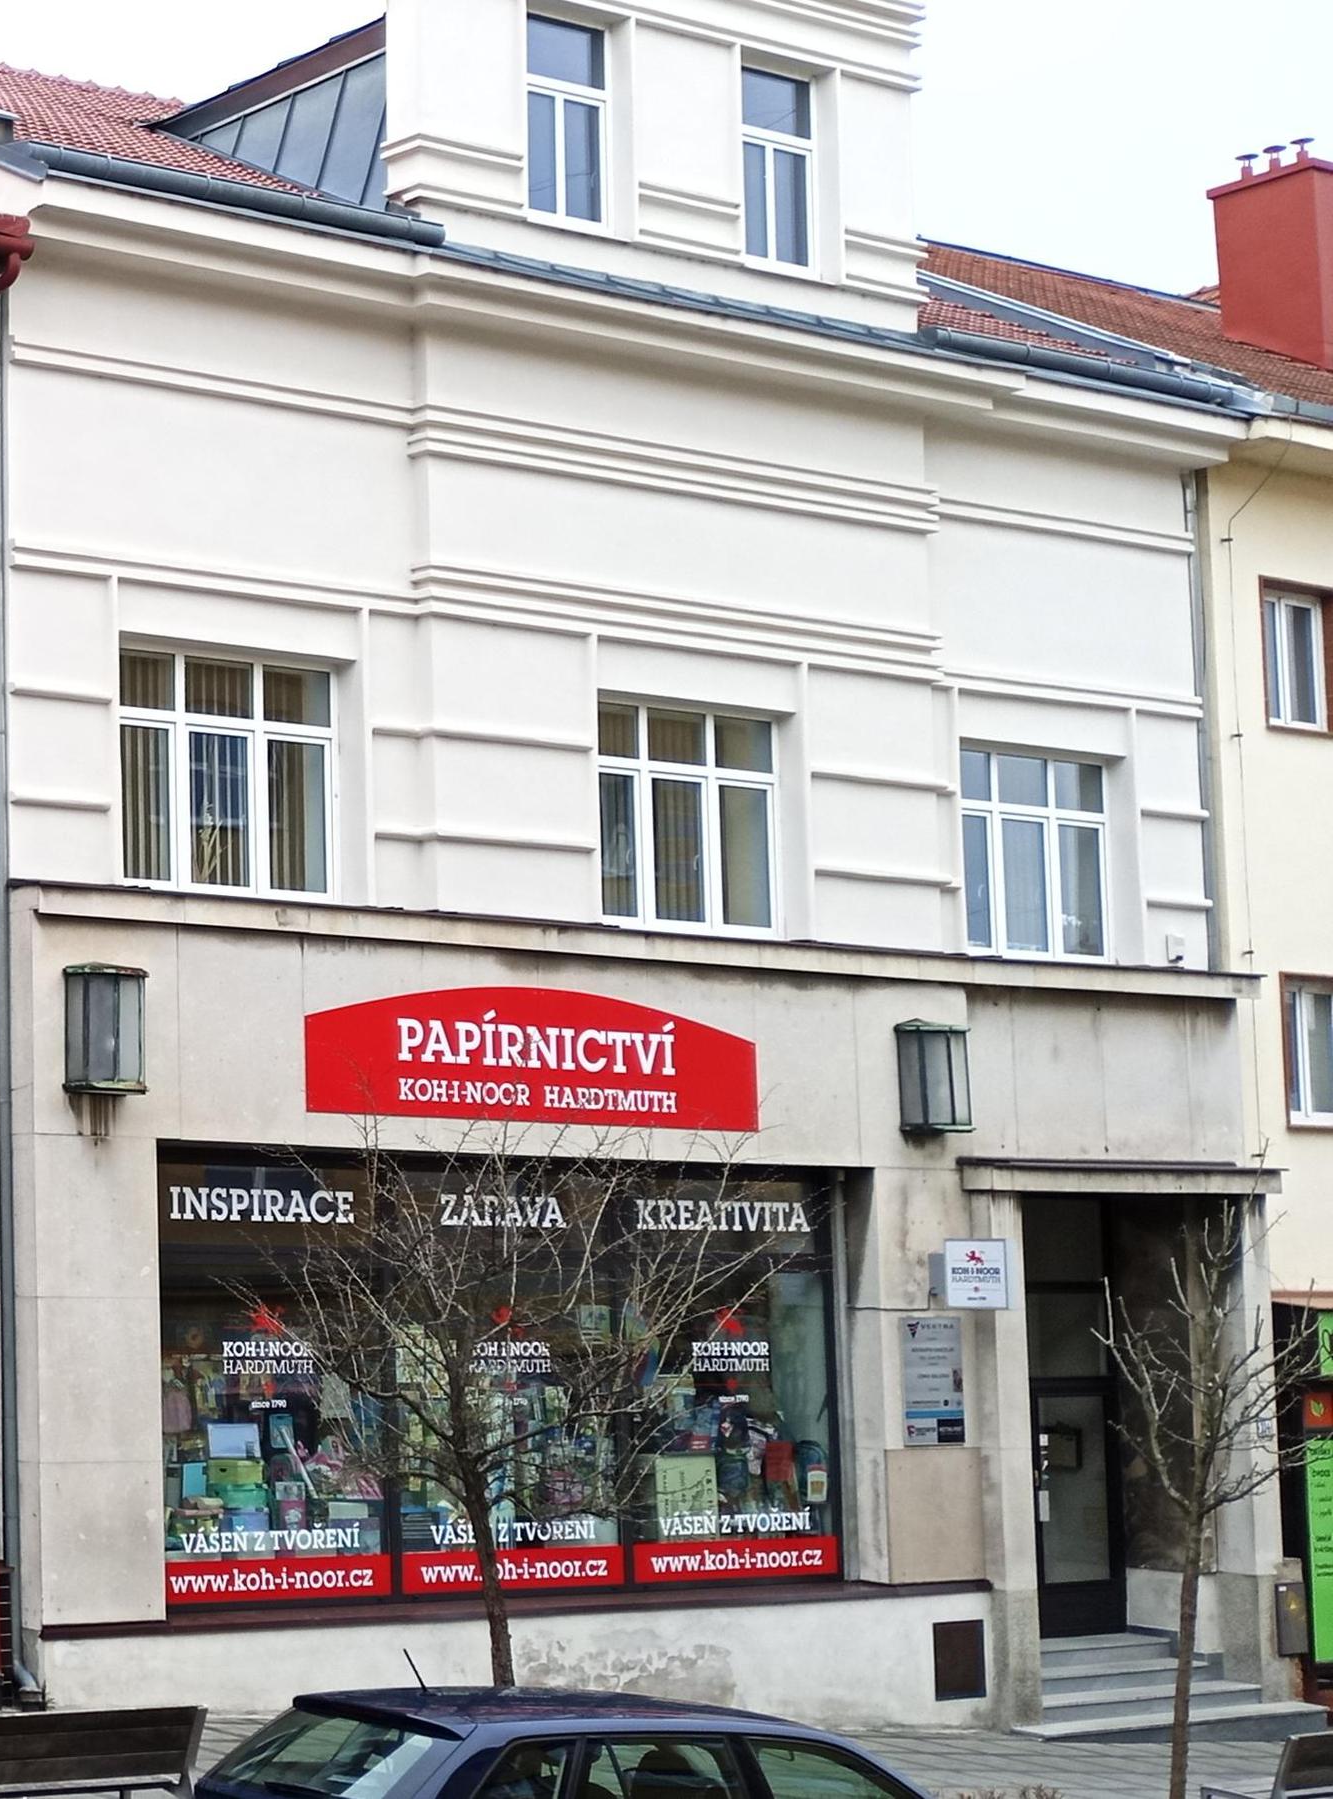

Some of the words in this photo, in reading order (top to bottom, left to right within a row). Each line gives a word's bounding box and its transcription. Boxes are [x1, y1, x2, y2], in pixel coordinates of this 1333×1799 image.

[396, 1008, 676, 1077] PAPÍRNICTVÍ
[398, 1077, 531, 1106] KOH-I-NOOR
[543, 1085, 677, 1113] HARDTMUTH
[169, 1186, 355, 1224] INSPIRACE
[440, 1184, 567, 1228] ZÁBAVA
[635, 1198, 811, 1233] KREATIVITA
[692, 1341, 769, 1357] KOH-I-NOOR
[223, 1360, 314, 1374] HARDTMUTH
[693, 1358, 770, 1372] HARDTMUTH
[251, 1400, 270, 1409] since
[498, 1522, 509, 1543] Z
[659, 1510, 717, 1537] VÁŠEŇ
[721, 1516, 732, 1534] Z
[732, 1506, 811, 1533] TVOŘENÍ
[182, 1526, 249, 1555] VÁŠEŇ
[253, 1531, 266, 1552] Z
[269, 1521, 361, 1551] TVOŘENÍ
[651, 1548, 823, 1573] www.koh-i-noor.cz
[170, 1566, 374, 1594] www.koh-i-noor.cz
